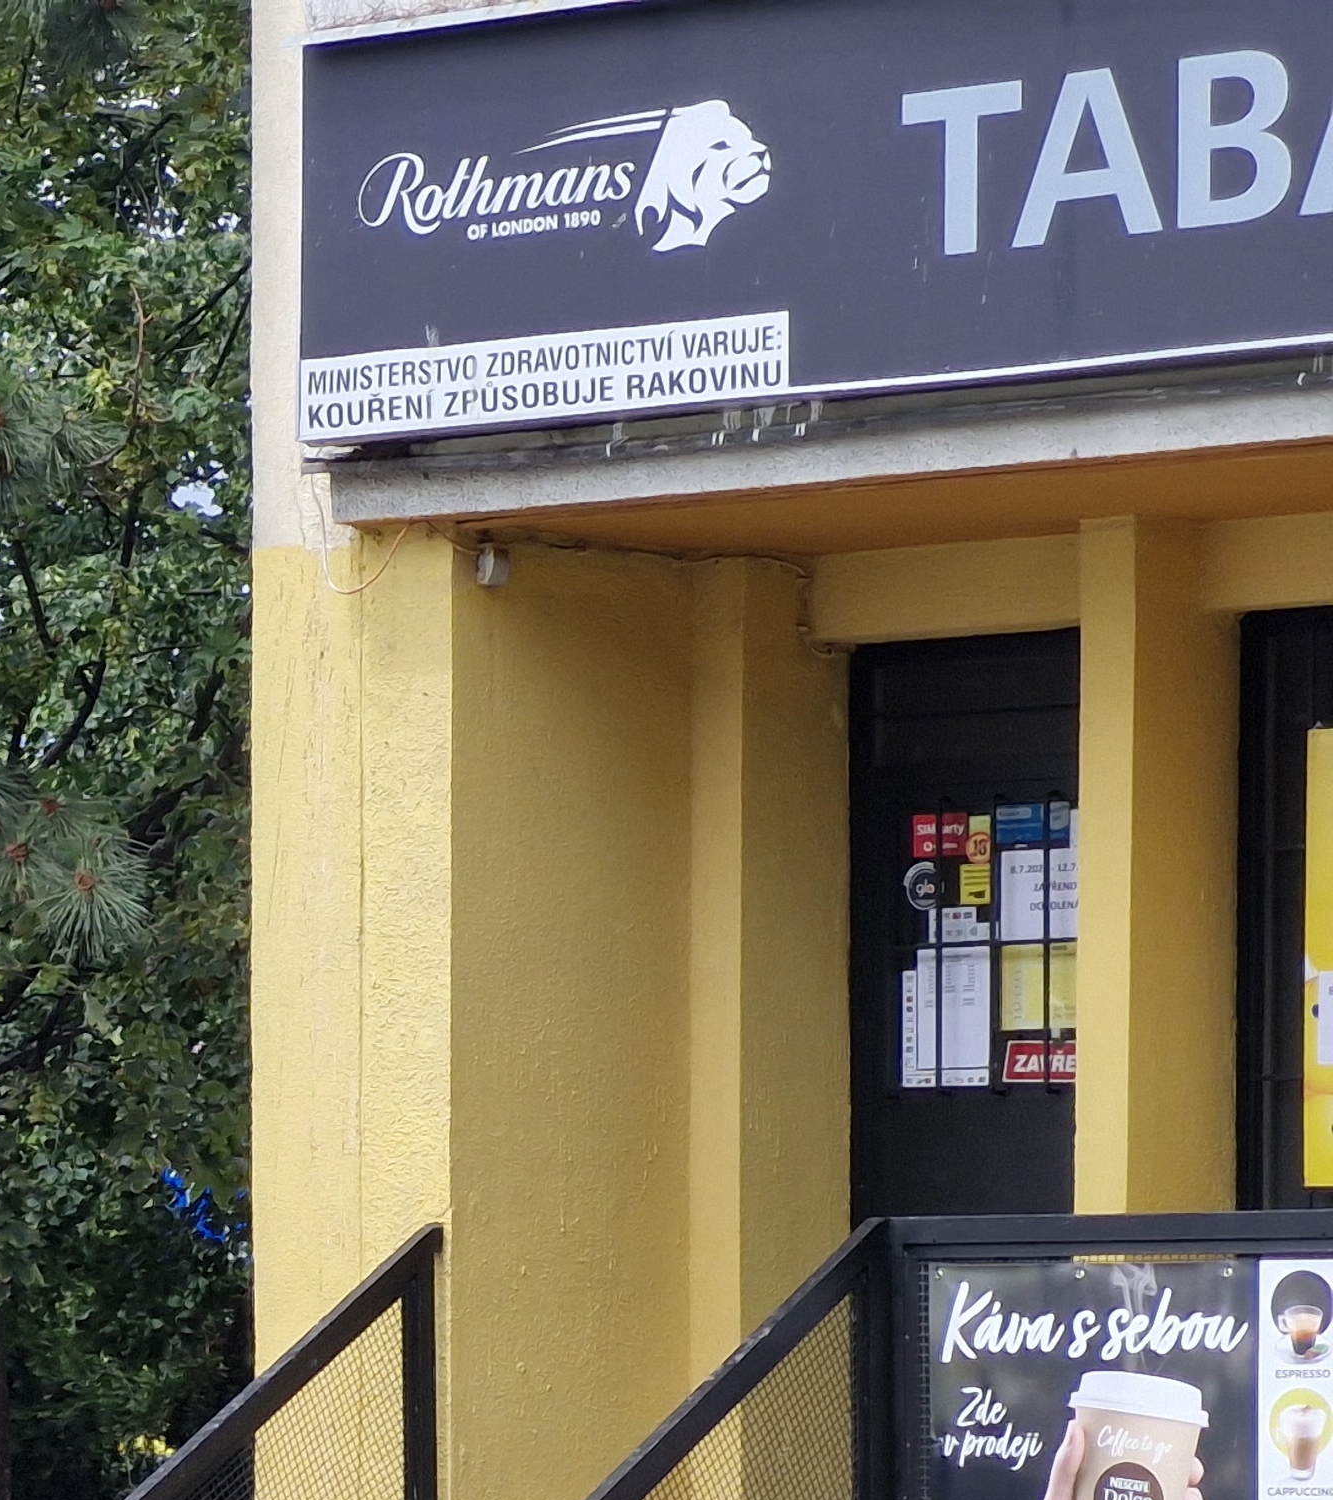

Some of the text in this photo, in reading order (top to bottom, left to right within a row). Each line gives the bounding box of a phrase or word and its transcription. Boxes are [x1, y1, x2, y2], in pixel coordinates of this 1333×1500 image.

[902, 50, 1333, 256] TAB
[358, 152, 636, 235] Rothmans
[466, 209, 602, 241] OF LONDON 1890
[308, 325, 782, 396] MINISTERSTVO ZDRAVOTNICTVÍ VARUJE:
[308, 359, 782, 430] KOUŘENÍ ZPŮSOBUJE RAKOVINU
[940, 1281, 1248, 1364] Káva s sebou
[1275, 1369, 1331, 1379] ESPRESSO
[956, 1387, 1006, 1428] Zde
[942, 1423, 1044, 1472] v prodeji
[1097, 1424, 1139, 1457] Coffee
